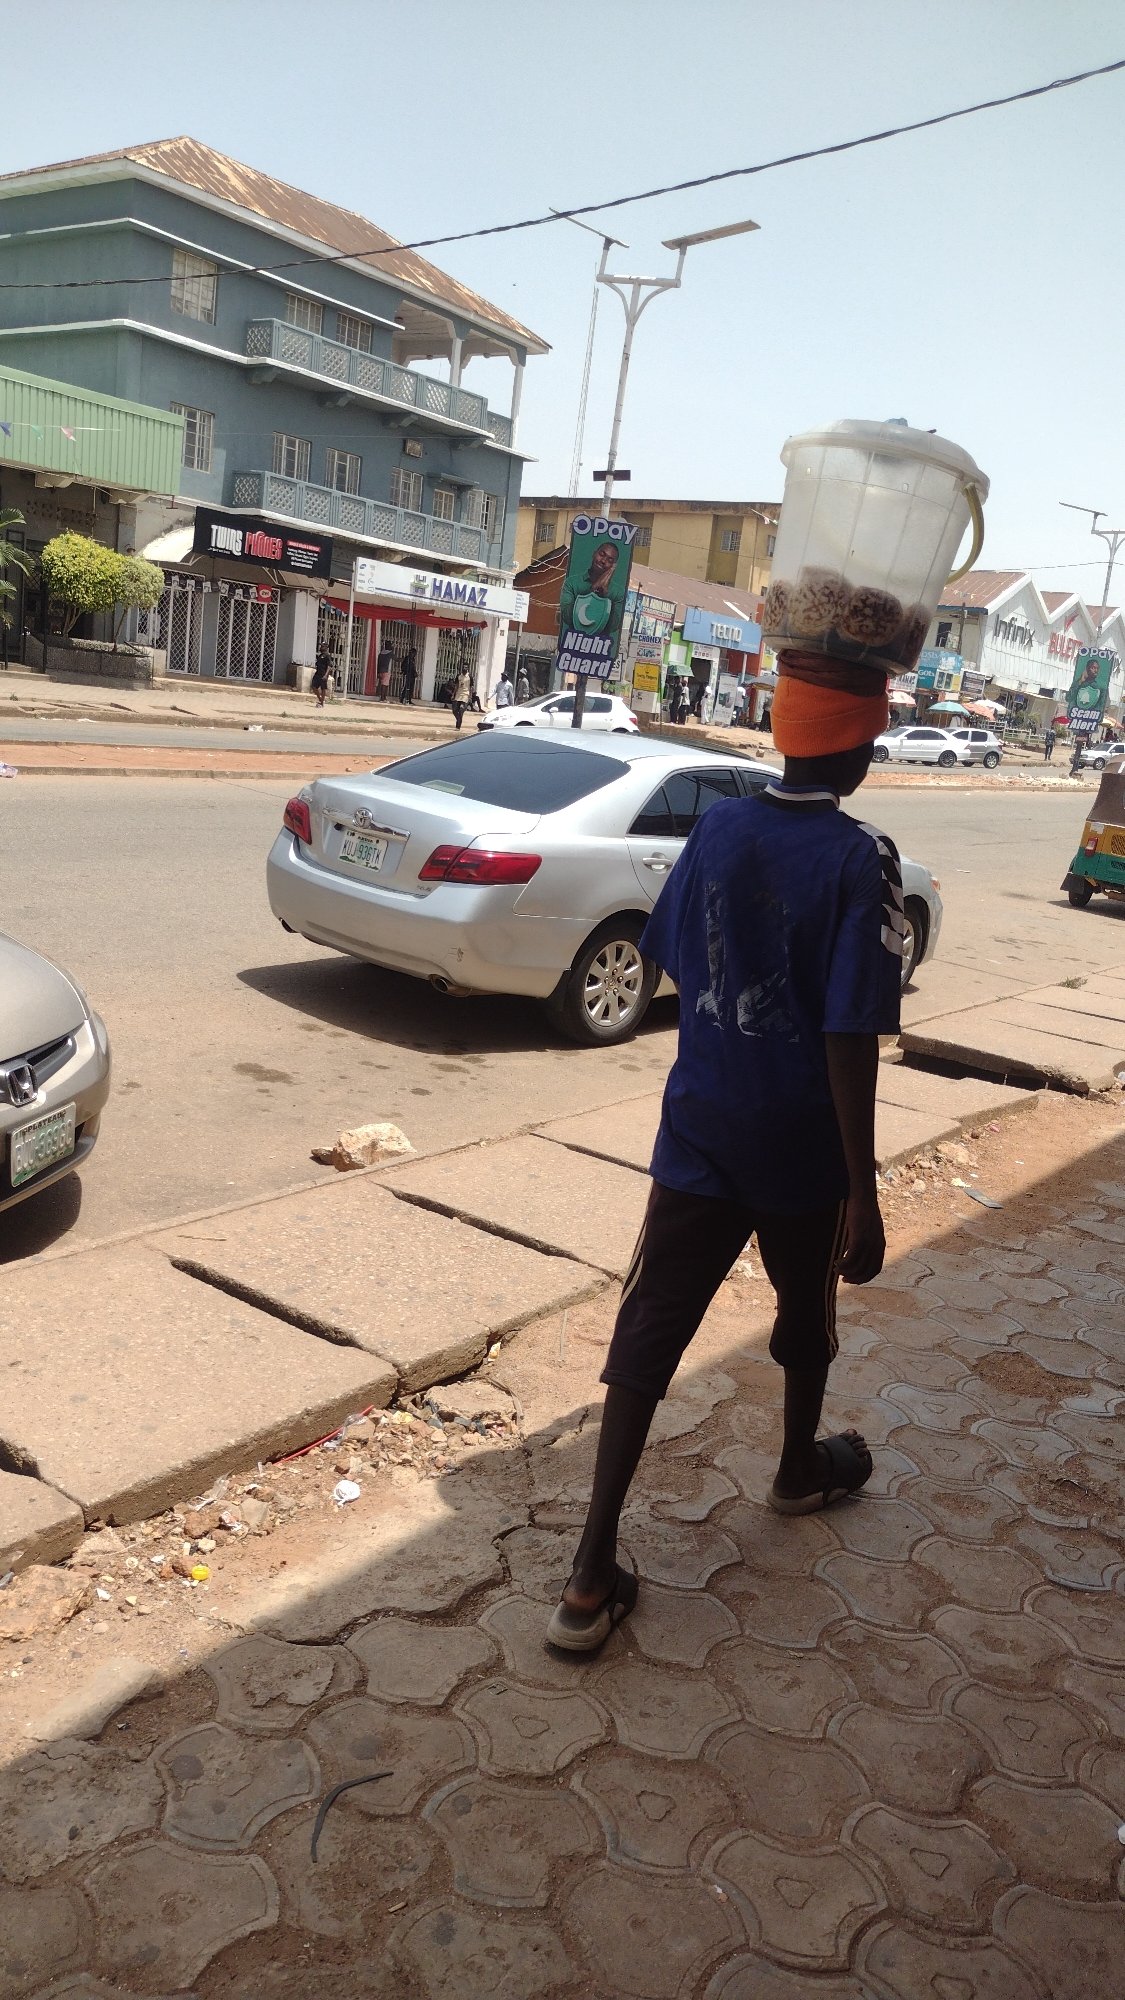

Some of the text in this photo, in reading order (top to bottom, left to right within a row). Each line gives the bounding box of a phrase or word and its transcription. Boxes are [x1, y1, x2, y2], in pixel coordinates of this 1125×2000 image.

[244, 530, 283, 561] PHONES
[431, 577, 488, 607] HAMAZ
[994, 613, 1035, 647] Infinix
[563, 631, 612, 656] Night
[558, 652, 612, 677] Guard
[1069, 718, 1097, 731] Alert
[1070, 707, 1101, 720] Scam
